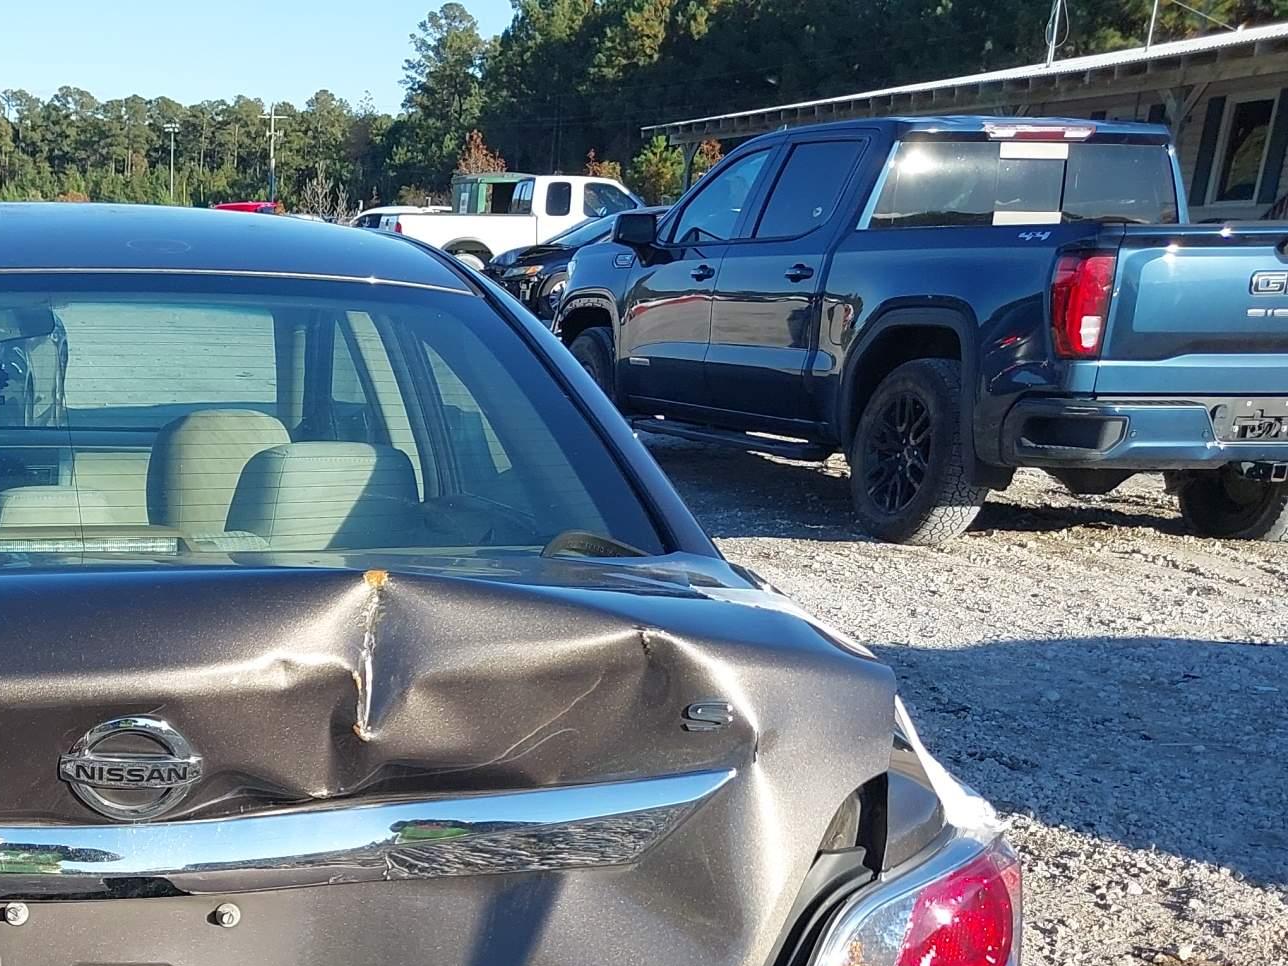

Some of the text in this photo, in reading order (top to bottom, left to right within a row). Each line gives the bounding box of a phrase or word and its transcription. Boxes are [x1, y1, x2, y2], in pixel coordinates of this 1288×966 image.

[1249, 270, 1288, 294] G
[680, 702, 733, 732] S
[74, 764, 188, 783] NISSAN
